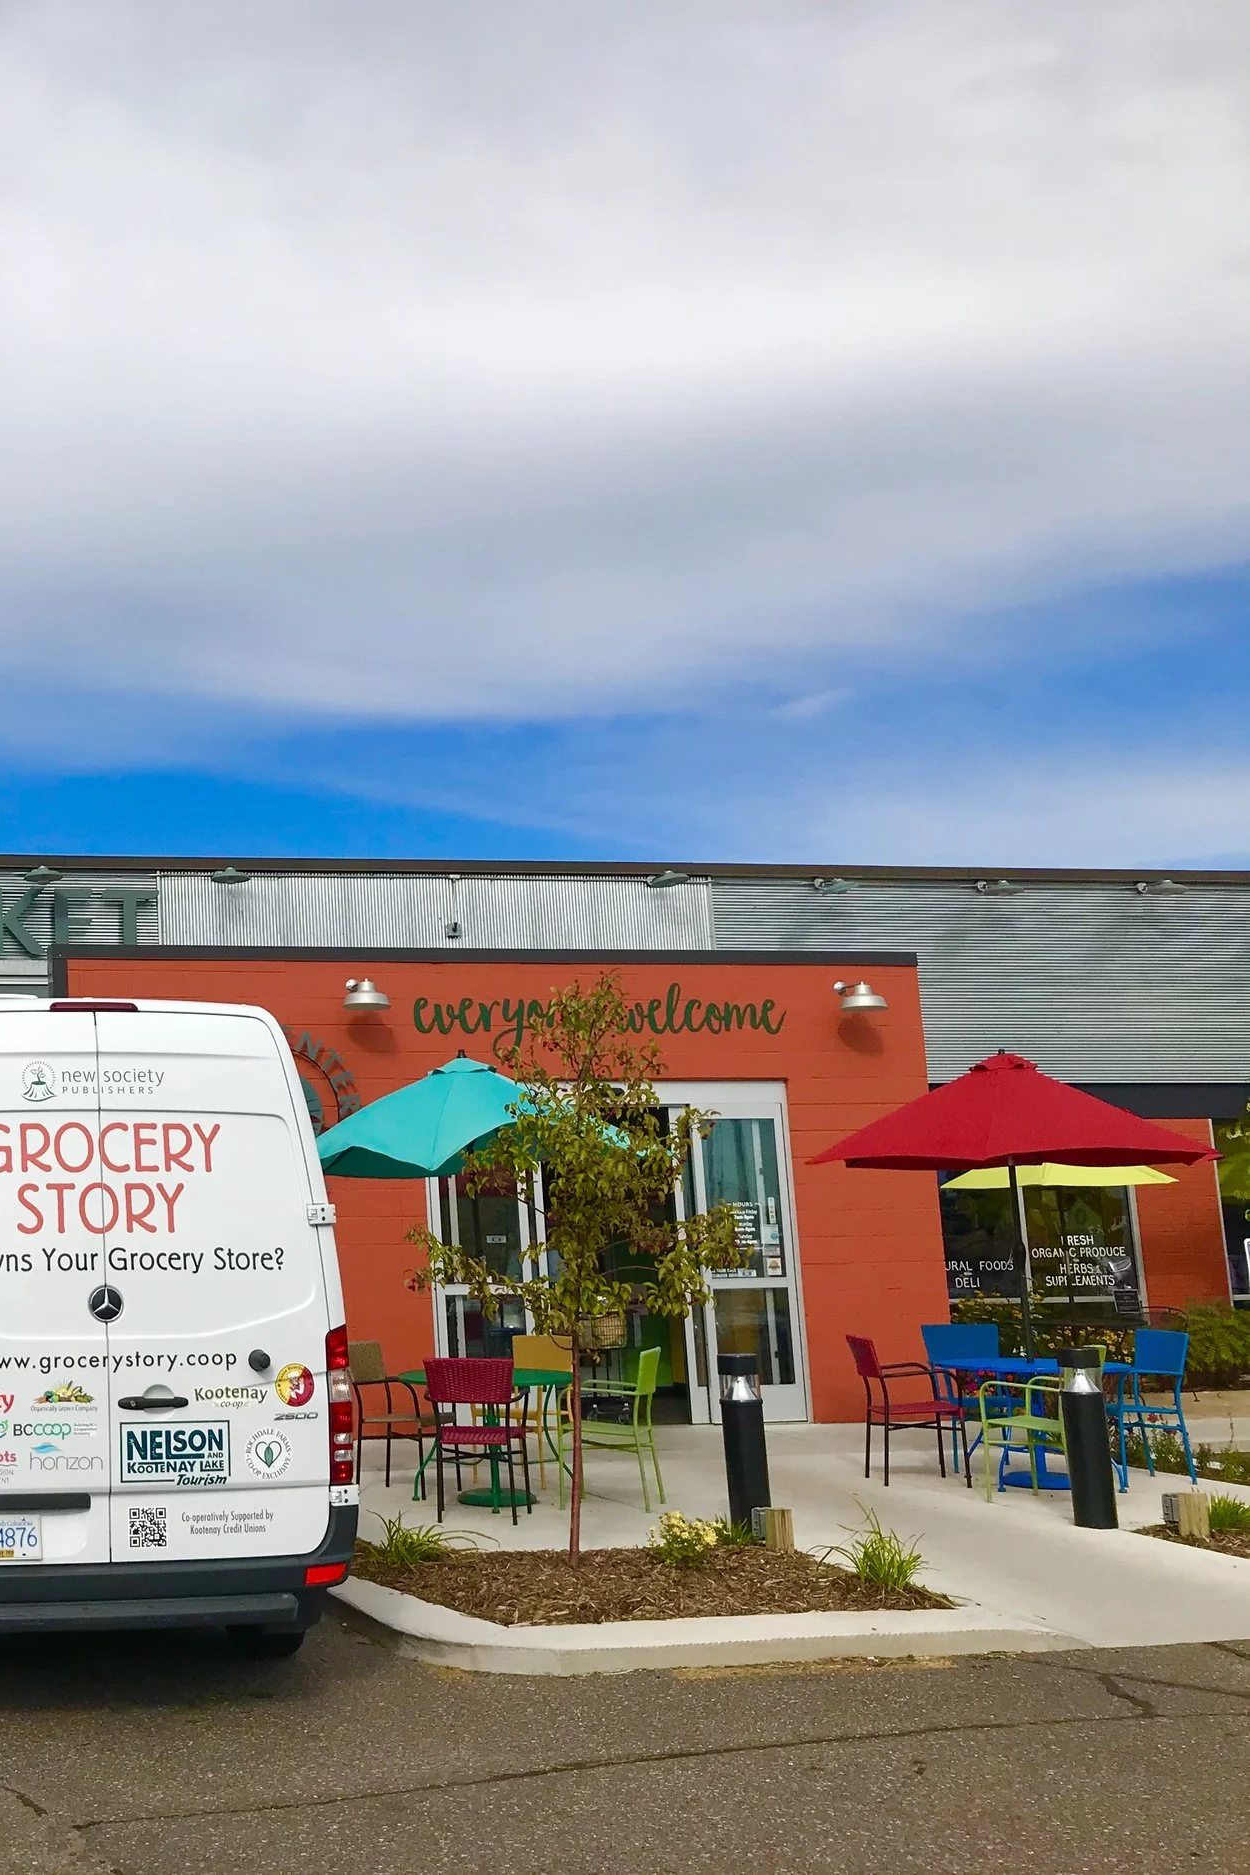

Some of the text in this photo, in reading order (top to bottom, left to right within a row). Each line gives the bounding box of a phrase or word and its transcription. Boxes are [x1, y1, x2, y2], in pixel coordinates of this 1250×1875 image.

[414, 983, 787, 1060] everyo welcome
[282, 1023, 362, 1116] NTER
[61, 1068, 165, 1087] new society
[62, 1086, 154, 1095] PUBLISHERS
[16, 1182, 185, 1235] STORY
[1031, 1246, 1126, 1259] ORGANC PRODUCE
[42, 1248, 99, 1272] Your
[108, 1247, 204, 1274] Grocery
[213, 1247, 284, 1271] Store?
[979, 1260, 1014, 1271] FOODS
[1060, 1263, 1094, 1274] HERBS
[955, 1277, 981, 1288] DELI
[194, 1386, 268, 1404] Kootenay
[220, 1401, 243, 1409] co-op
[274, 1411, 318, 1421] 2500
[127, 1429, 223, 1460] NELSON
[29, 1451, 104, 1470] horizon
[127, 1460, 225, 1473] KOOTENAY LAKE
[176, 1474, 228, 1486] Tourism
[181, 1508, 274, 1524] Co-operatively Supported by
[190, 1522, 267, 1537] Kootenay Credit Unions
